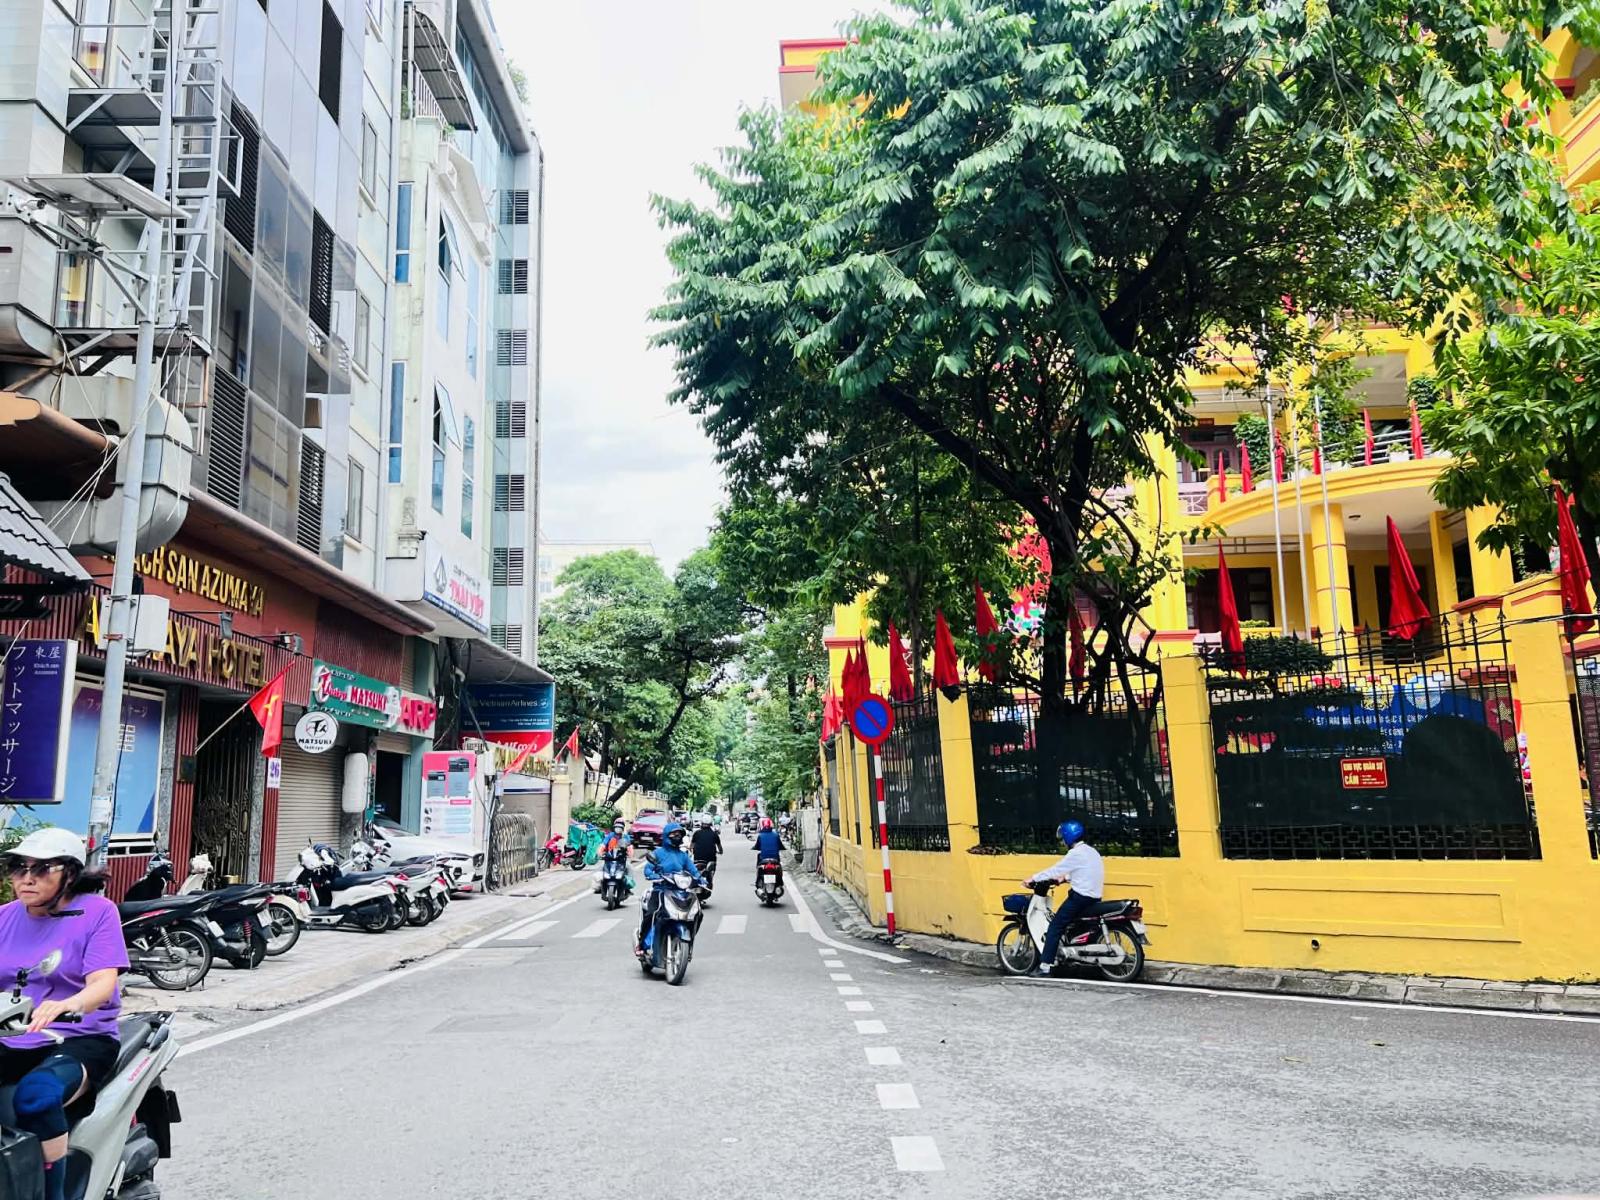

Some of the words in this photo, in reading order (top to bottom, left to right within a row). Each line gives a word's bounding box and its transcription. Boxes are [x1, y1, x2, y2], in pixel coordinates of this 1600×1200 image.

[166, 550, 199, 594] SẠN
[350, 686, 388, 712] MATSUKI
[400, 696, 437, 731] ARP
